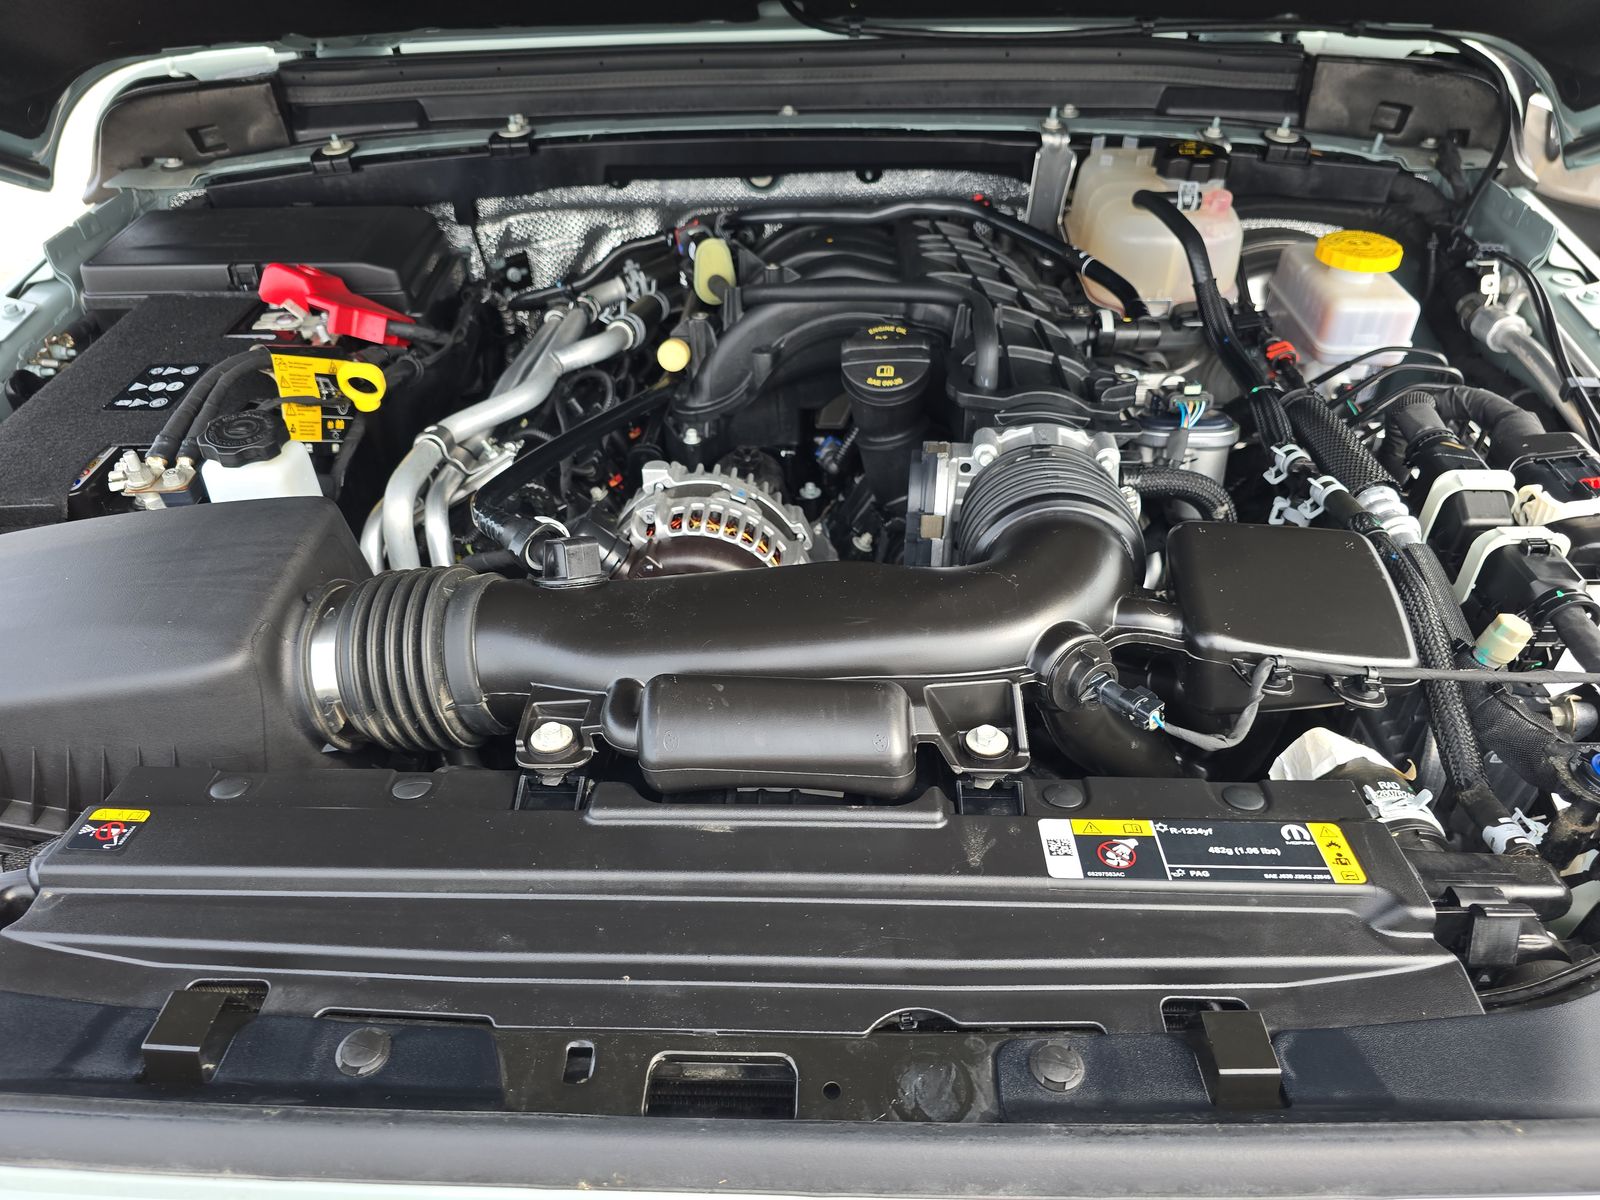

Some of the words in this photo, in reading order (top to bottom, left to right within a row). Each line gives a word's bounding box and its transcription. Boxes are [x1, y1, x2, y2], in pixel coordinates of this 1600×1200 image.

[868, 326, 895, 335] ENGINE
[1377, 781, 1400, 790] RAD
[1169, 827, 1213, 837] R-1234yf
[1260, 847, 1281, 857] lbs)
[1189, 870, 1210, 878] PAG
